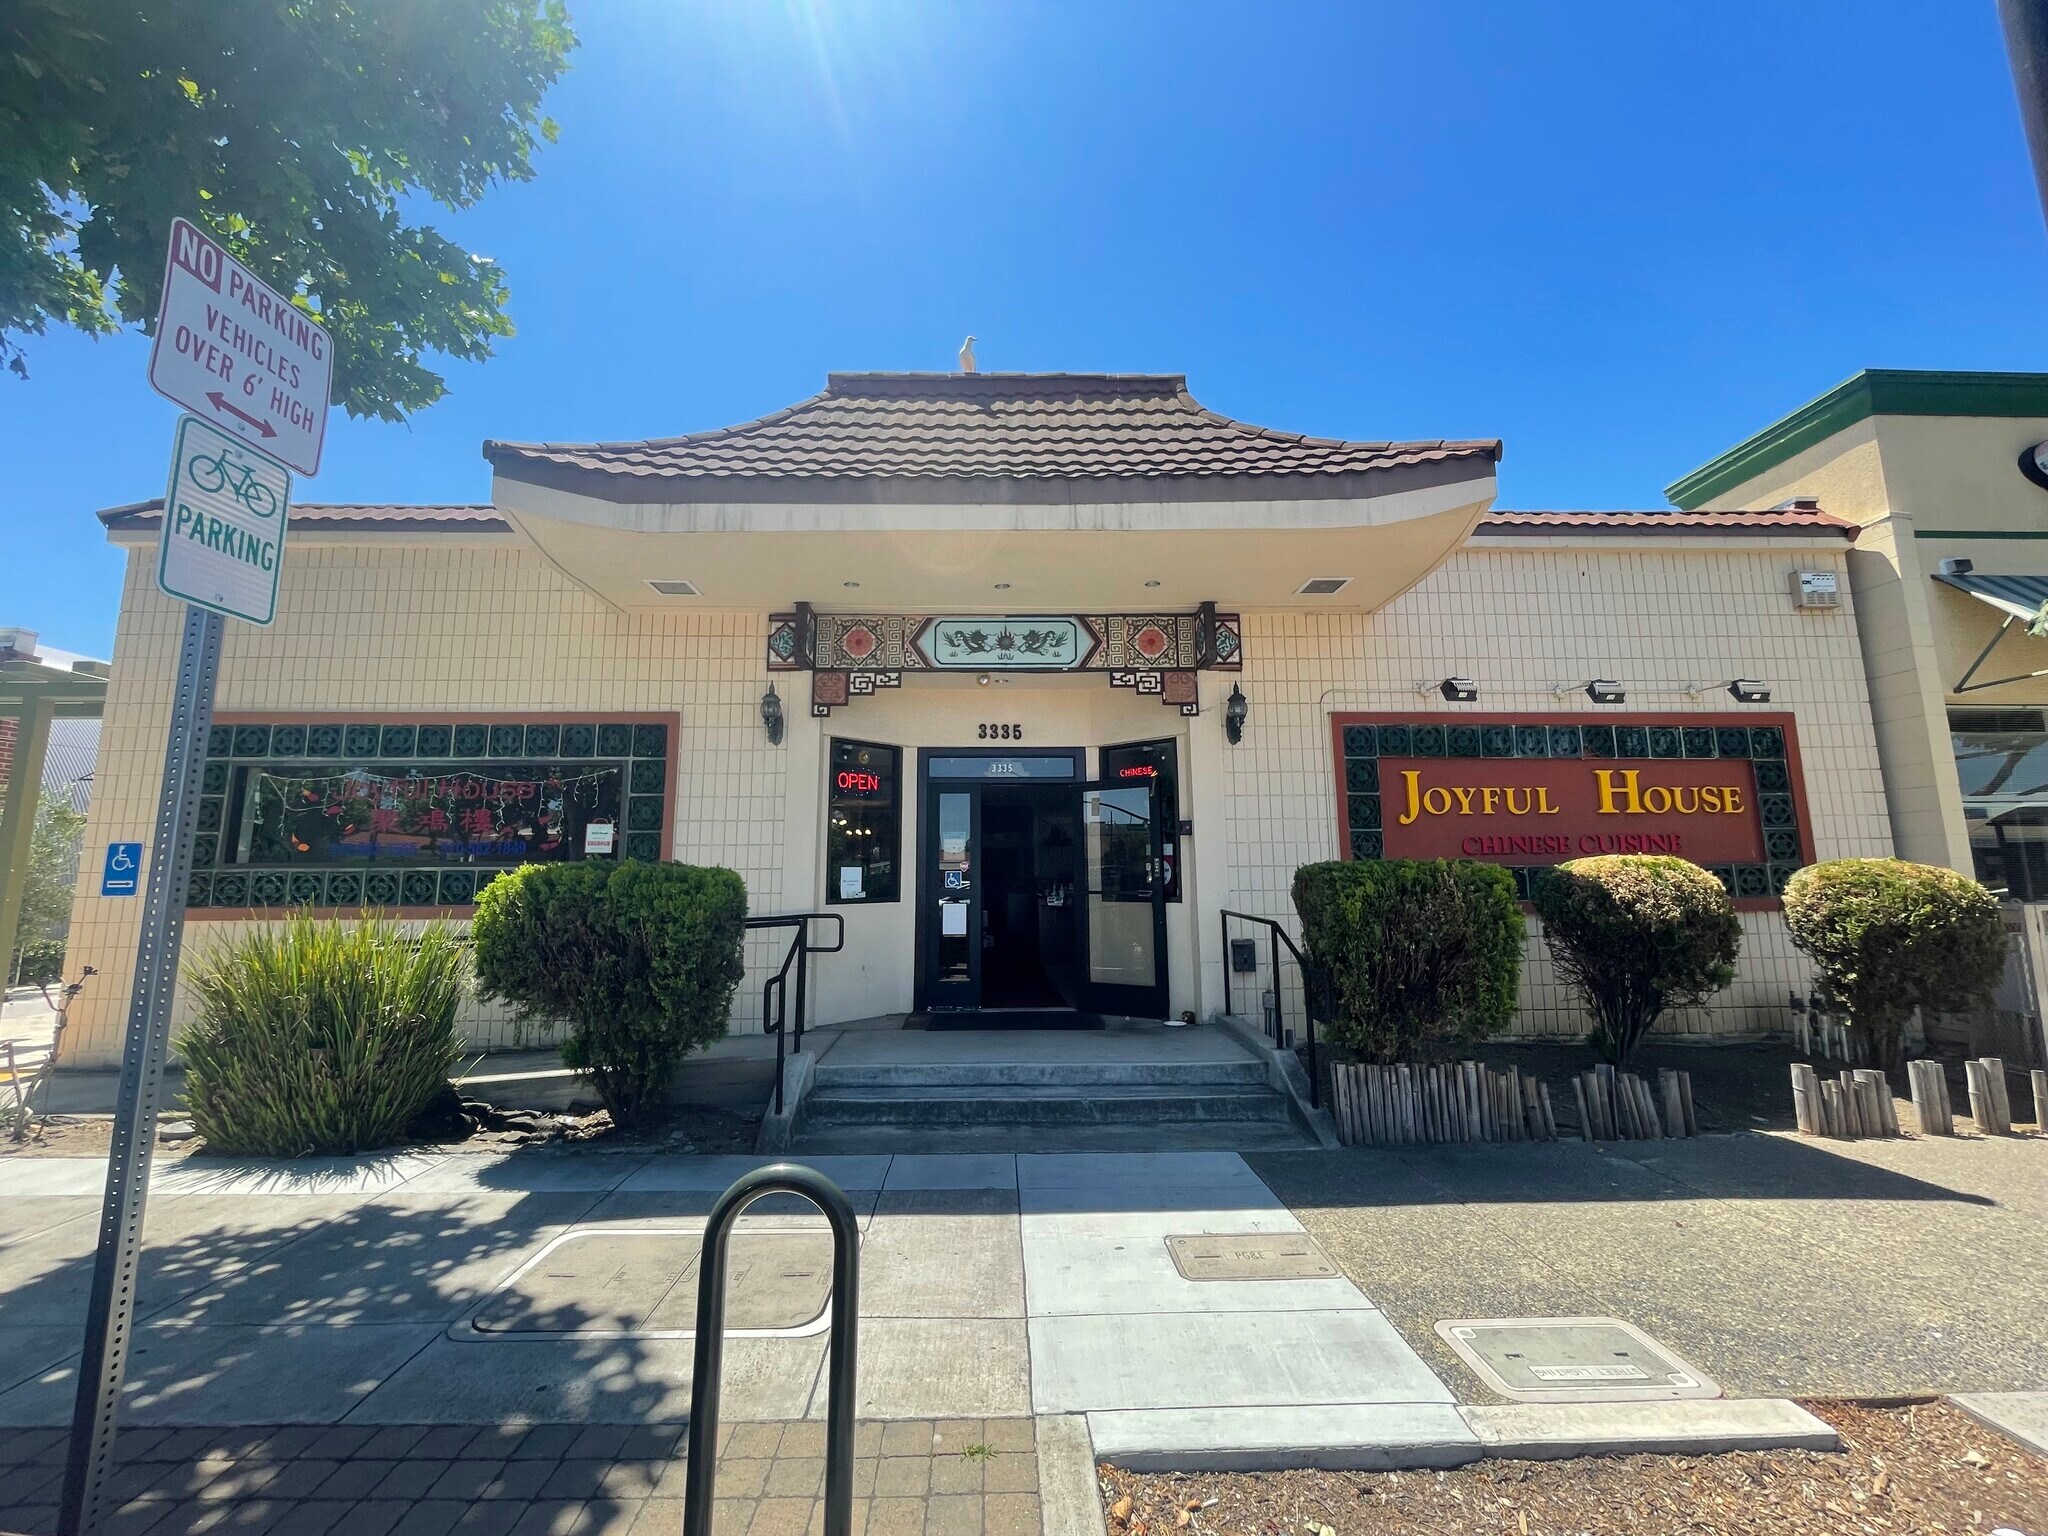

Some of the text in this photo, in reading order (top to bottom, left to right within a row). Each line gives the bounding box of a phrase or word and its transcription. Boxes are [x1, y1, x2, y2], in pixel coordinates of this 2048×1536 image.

[179, 226, 324, 362] NO PARKING
[206, 302, 301, 390] VEHICLES
[175, 325, 315, 434] OVER 6' HIGH
[175, 503, 275, 572] PARKING
[978, 723, 1022, 740] 3335
[991, 763, 1014, 773] 3335
[1119, 765, 1154, 777] CHINESE
[838, 771, 878, 791] OPEN
[1398, 768, 1746, 826] JOYFUL HOUSE
[1461, 832, 1683, 856] CHINESE CUISINE
[1235, 1251, 1267, 1260] PG&E
